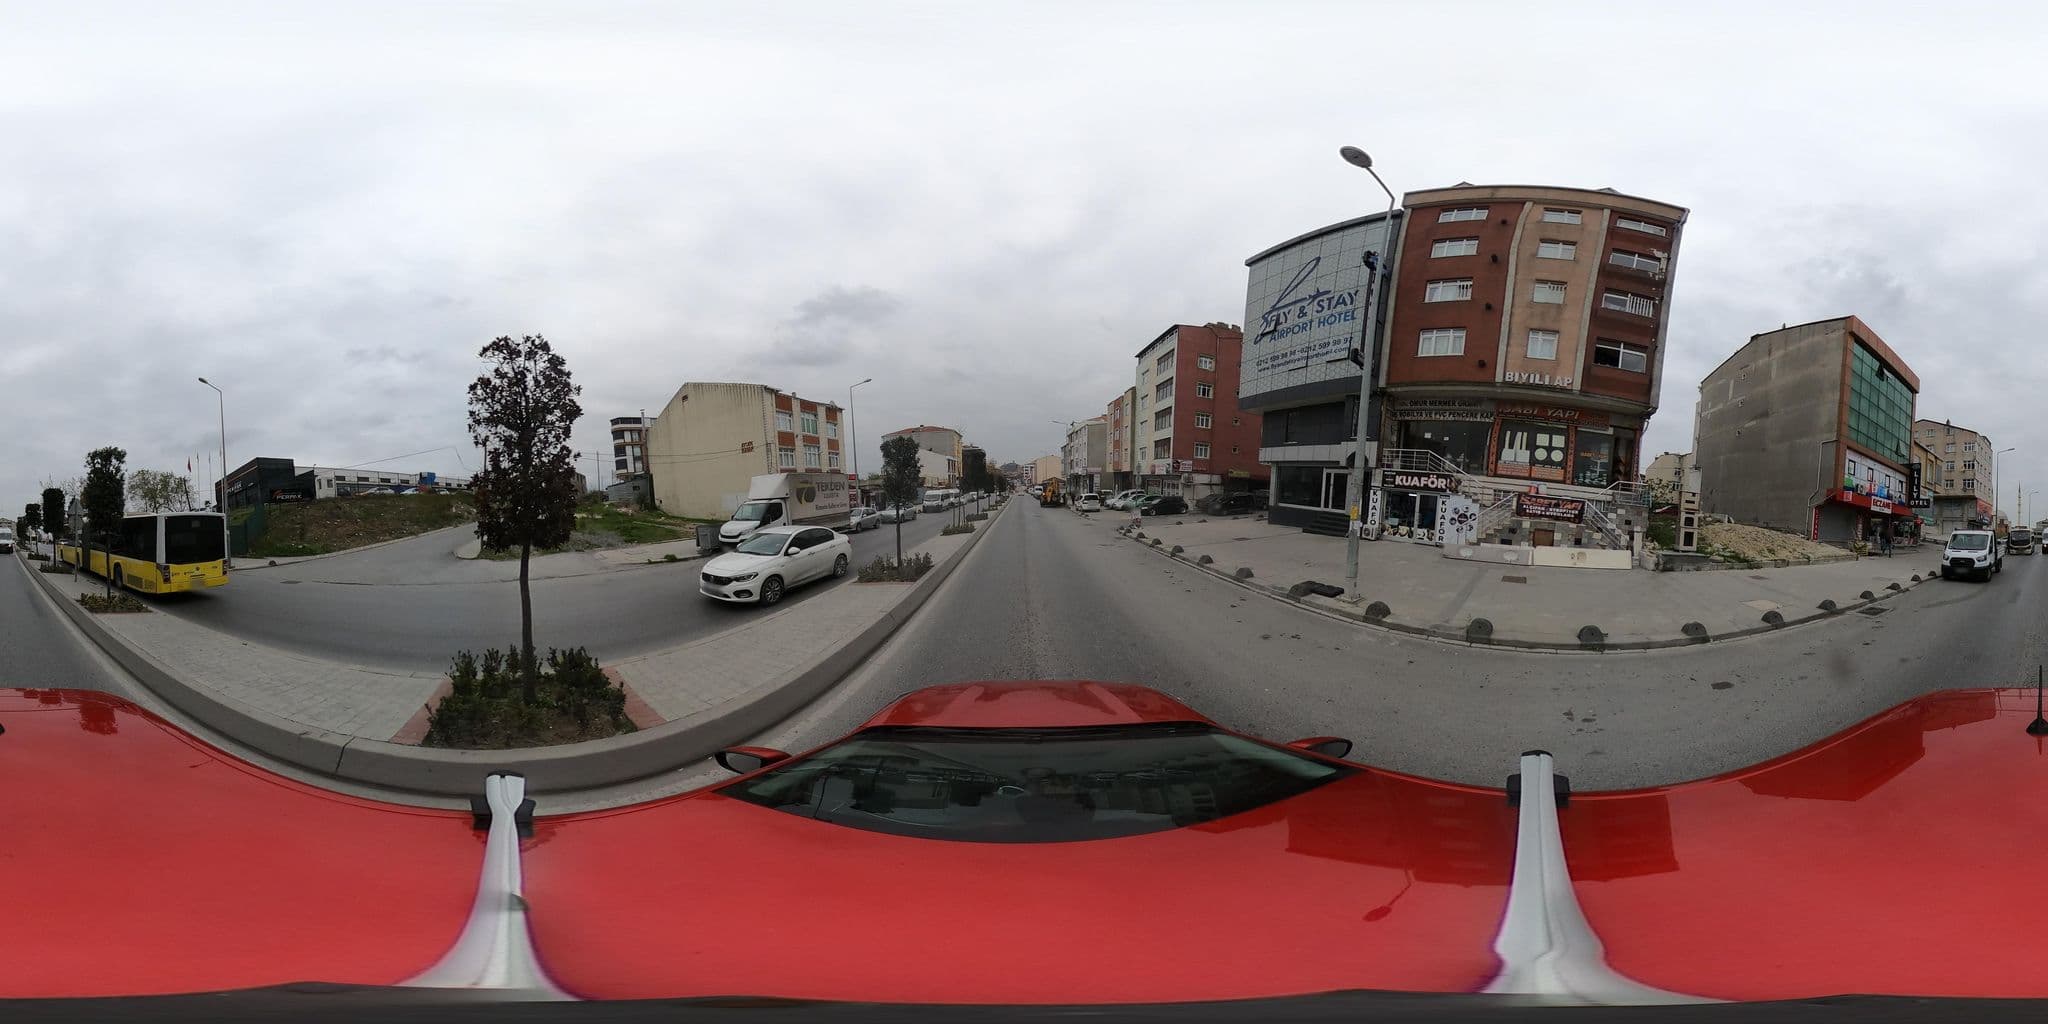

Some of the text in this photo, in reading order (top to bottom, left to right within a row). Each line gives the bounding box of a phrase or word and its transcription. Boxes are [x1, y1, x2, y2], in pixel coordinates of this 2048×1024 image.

[1297, 305, 1307, 319] &
[1315, 290, 1359, 313] STAY
[1269, 310, 1357, 342] AIRPORT HOTEL
[1545, 408, 1581, 419] YAPI
[1395, 474, 1447, 489] KUAFÖR
